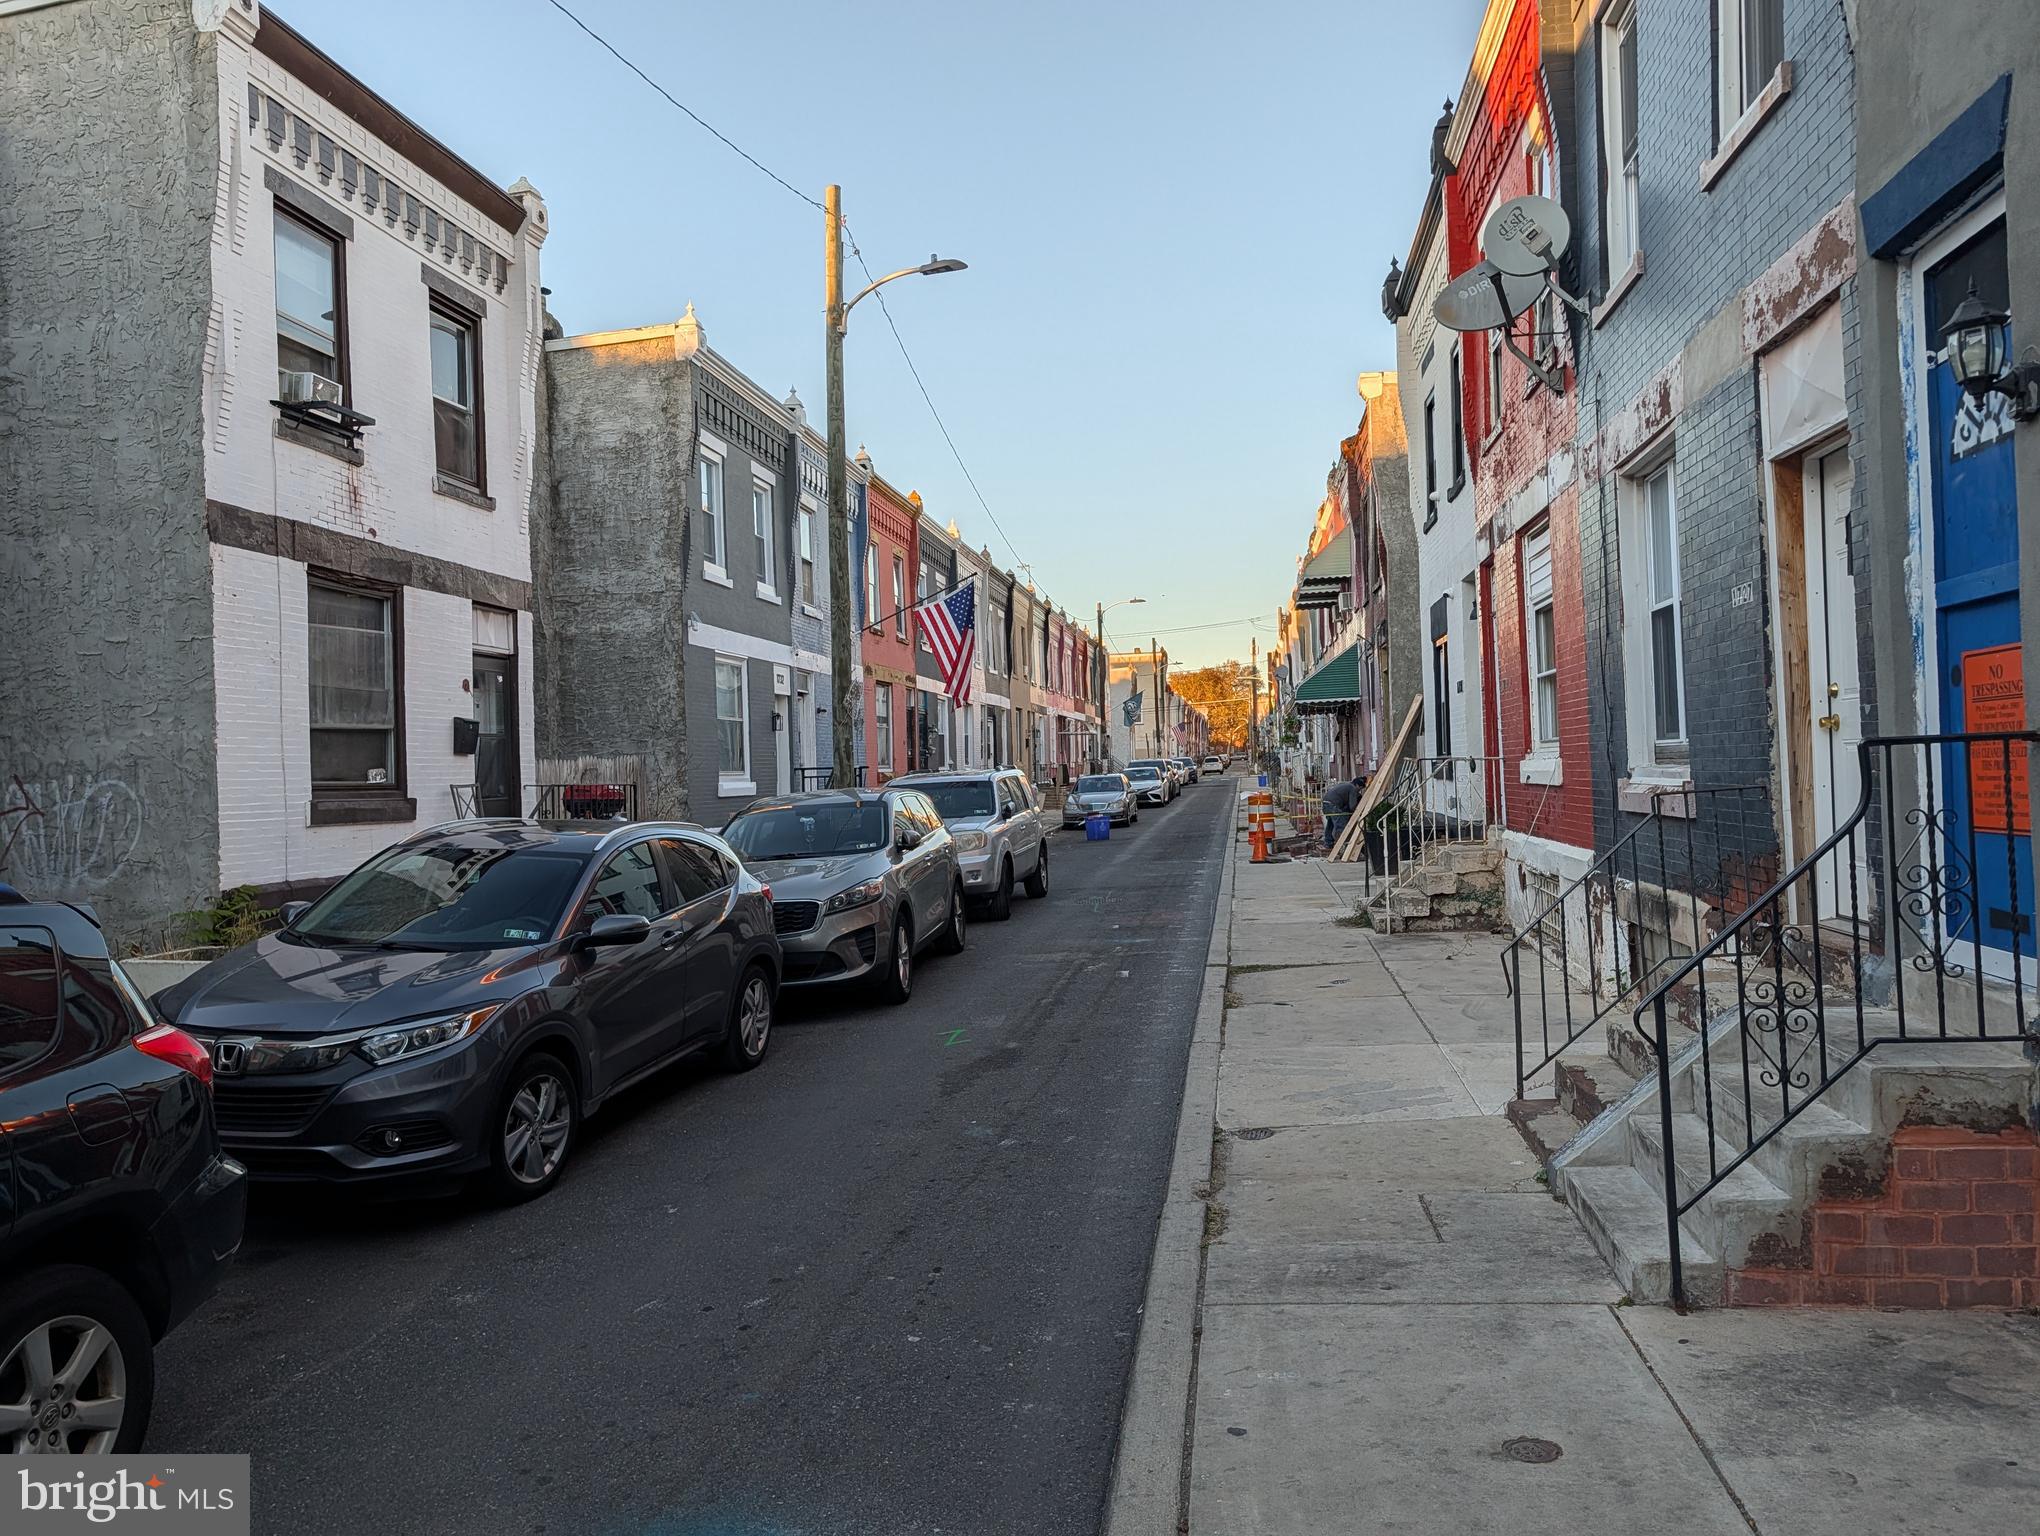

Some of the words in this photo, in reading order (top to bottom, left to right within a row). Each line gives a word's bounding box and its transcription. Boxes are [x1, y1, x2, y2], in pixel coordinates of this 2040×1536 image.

[1498, 207, 1527, 237] dish
[1989, 664, 2003, 680] NO
[1971, 680, 2023, 698] TRESPASSING
